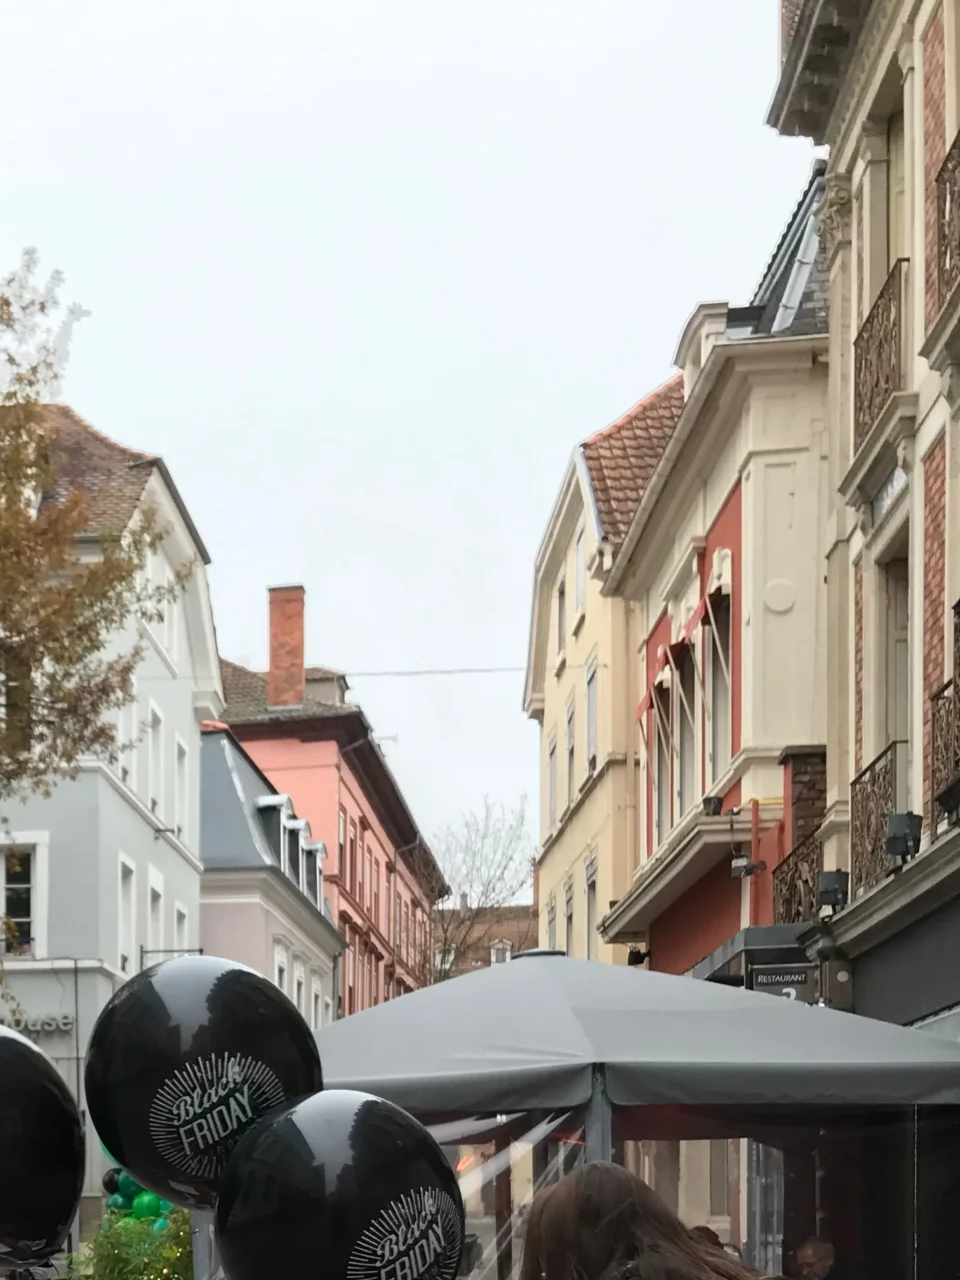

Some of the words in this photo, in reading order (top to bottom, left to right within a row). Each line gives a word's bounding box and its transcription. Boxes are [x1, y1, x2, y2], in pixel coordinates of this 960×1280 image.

[757, 973, 806, 983] RESTAURANT
[172, 1056, 242, 1126] Black
[179, 1083, 253, 1155] FRIDAY
[375, 1190, 439, 1267] Black
